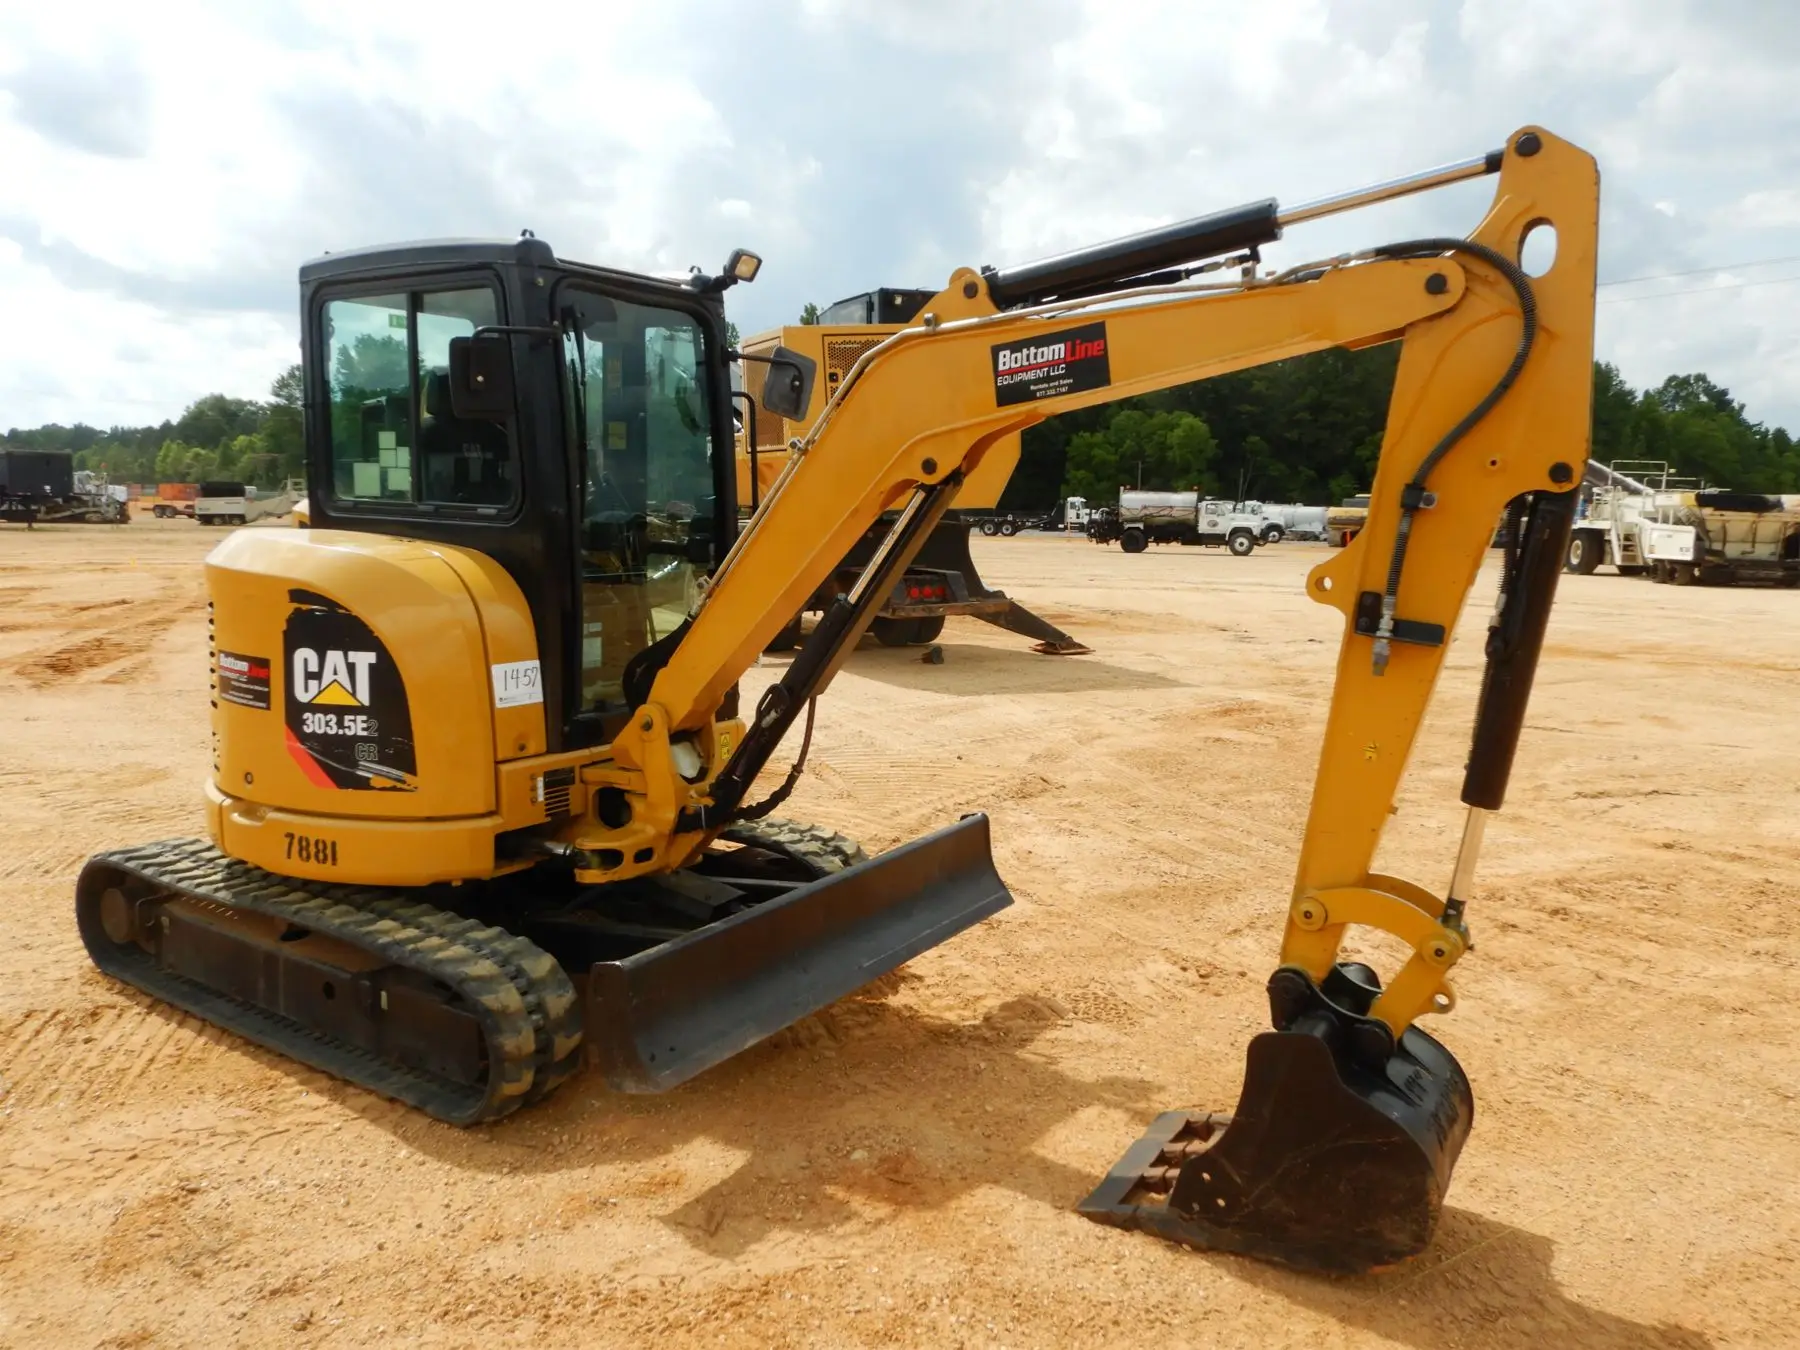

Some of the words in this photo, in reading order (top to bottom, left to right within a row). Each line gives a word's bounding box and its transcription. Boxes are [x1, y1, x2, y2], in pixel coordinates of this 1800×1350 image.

[997, 367, 1048, 386] EQUIPMENT
[1050, 364, 1066, 376] LLC
[293, 647, 377, 707] CAT
[504, 666, 539, 692] 1457
[354, 742, 379, 761] CR
[284, 831, 338, 867] 7881
